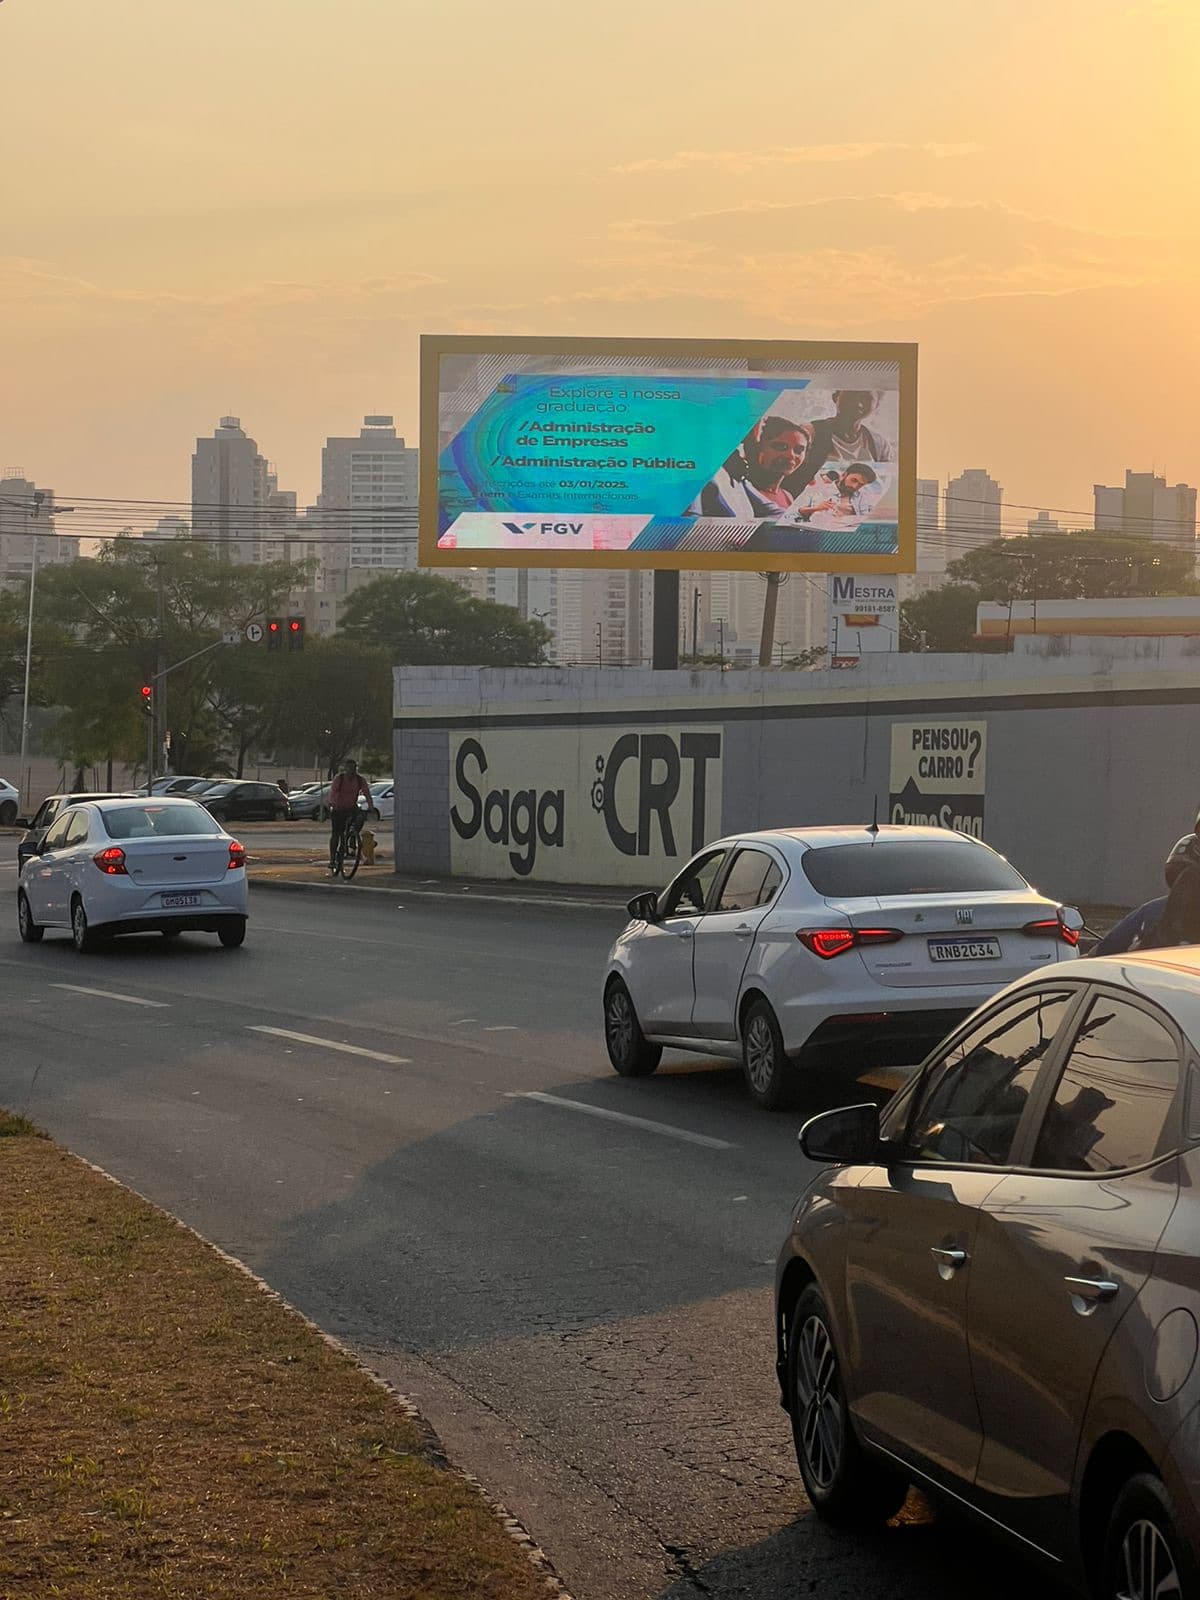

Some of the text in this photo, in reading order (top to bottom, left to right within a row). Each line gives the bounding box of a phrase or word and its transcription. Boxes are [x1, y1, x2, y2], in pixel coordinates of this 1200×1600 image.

[550, 386, 614, 402] Explore
[633, 389, 681, 400] nossa
[516, 435, 629, 449] de Empresas
[632, 456, 696, 470] Pública
[540, 523, 584, 535] FGV
[833, 576, 895, 600] MESTRA
[912, 728, 969, 751] PENSOU
[918, 755, 964, 779] CARRO
[450, 732, 721, 876] Saga CRT
[936, 944, 994, 960] RNB2C34
